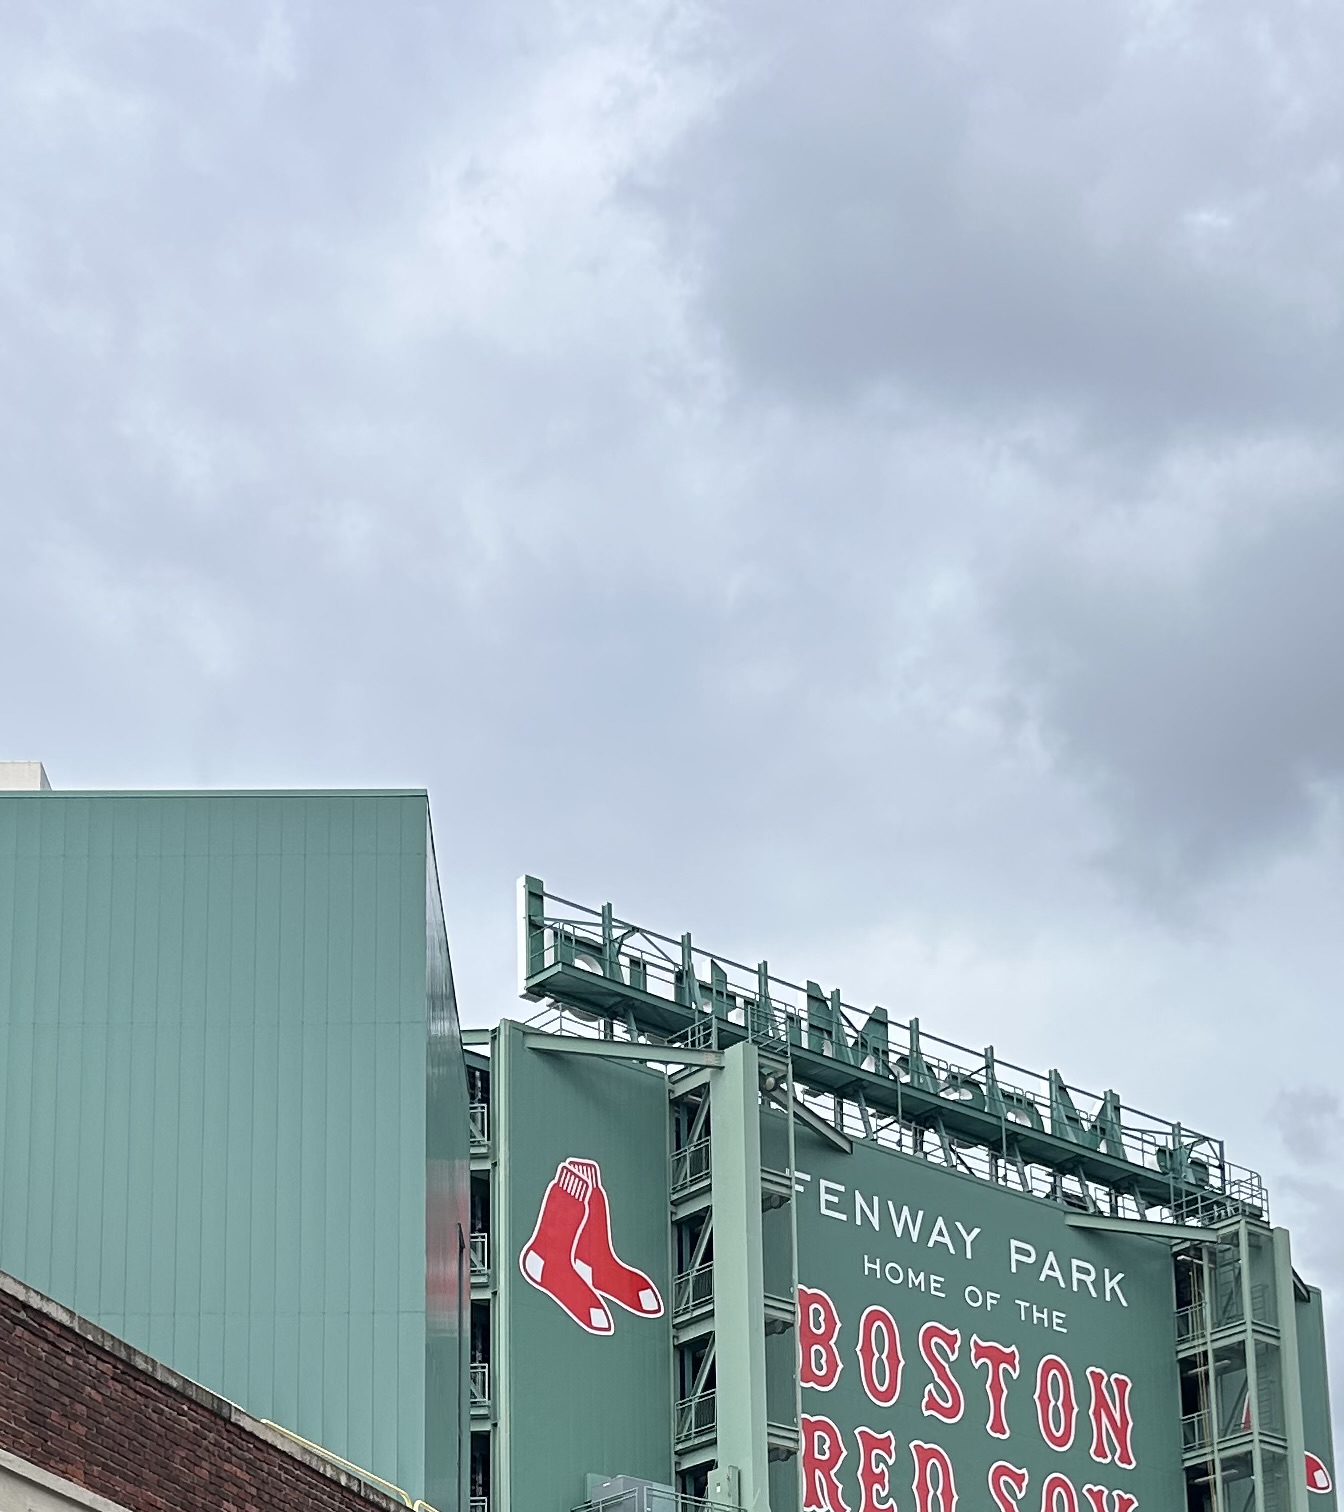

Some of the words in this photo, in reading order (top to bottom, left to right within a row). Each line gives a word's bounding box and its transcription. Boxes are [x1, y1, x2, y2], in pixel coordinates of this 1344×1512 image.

[864, 1254, 946, 1298] HOME
[965, 1286, 1000, 1311] OF
[1015, 1299, 1067, 1333] THE
[1010, 1238, 1129, 1307] PARK
[797, 1284, 1136, 1469] BOSTON
